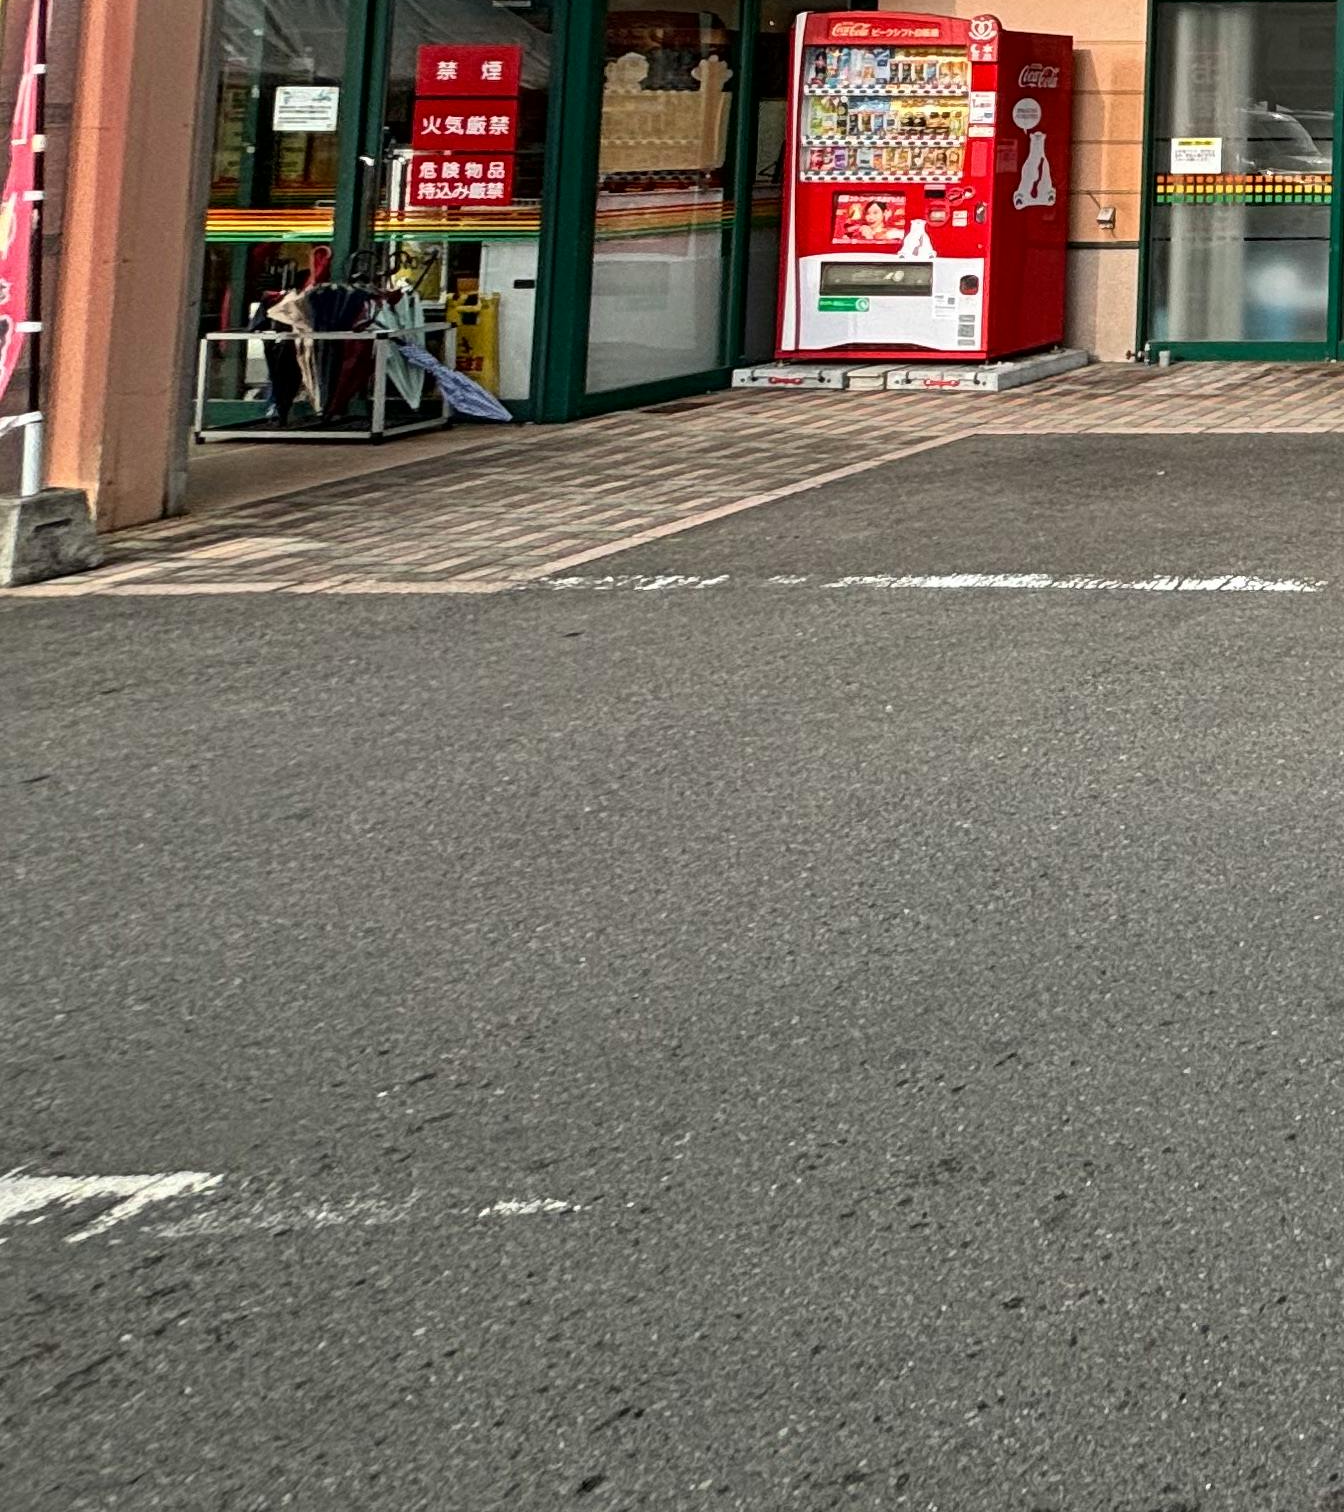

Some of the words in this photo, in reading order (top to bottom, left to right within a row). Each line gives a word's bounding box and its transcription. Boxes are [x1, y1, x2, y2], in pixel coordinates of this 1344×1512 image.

[435, 59, 504, 81] 禁煙
[420, 115, 511, 136] 火気厳禁
[418, 161, 506, 180] 危険物品
[417, 182, 505, 200] 持込み厳禁
